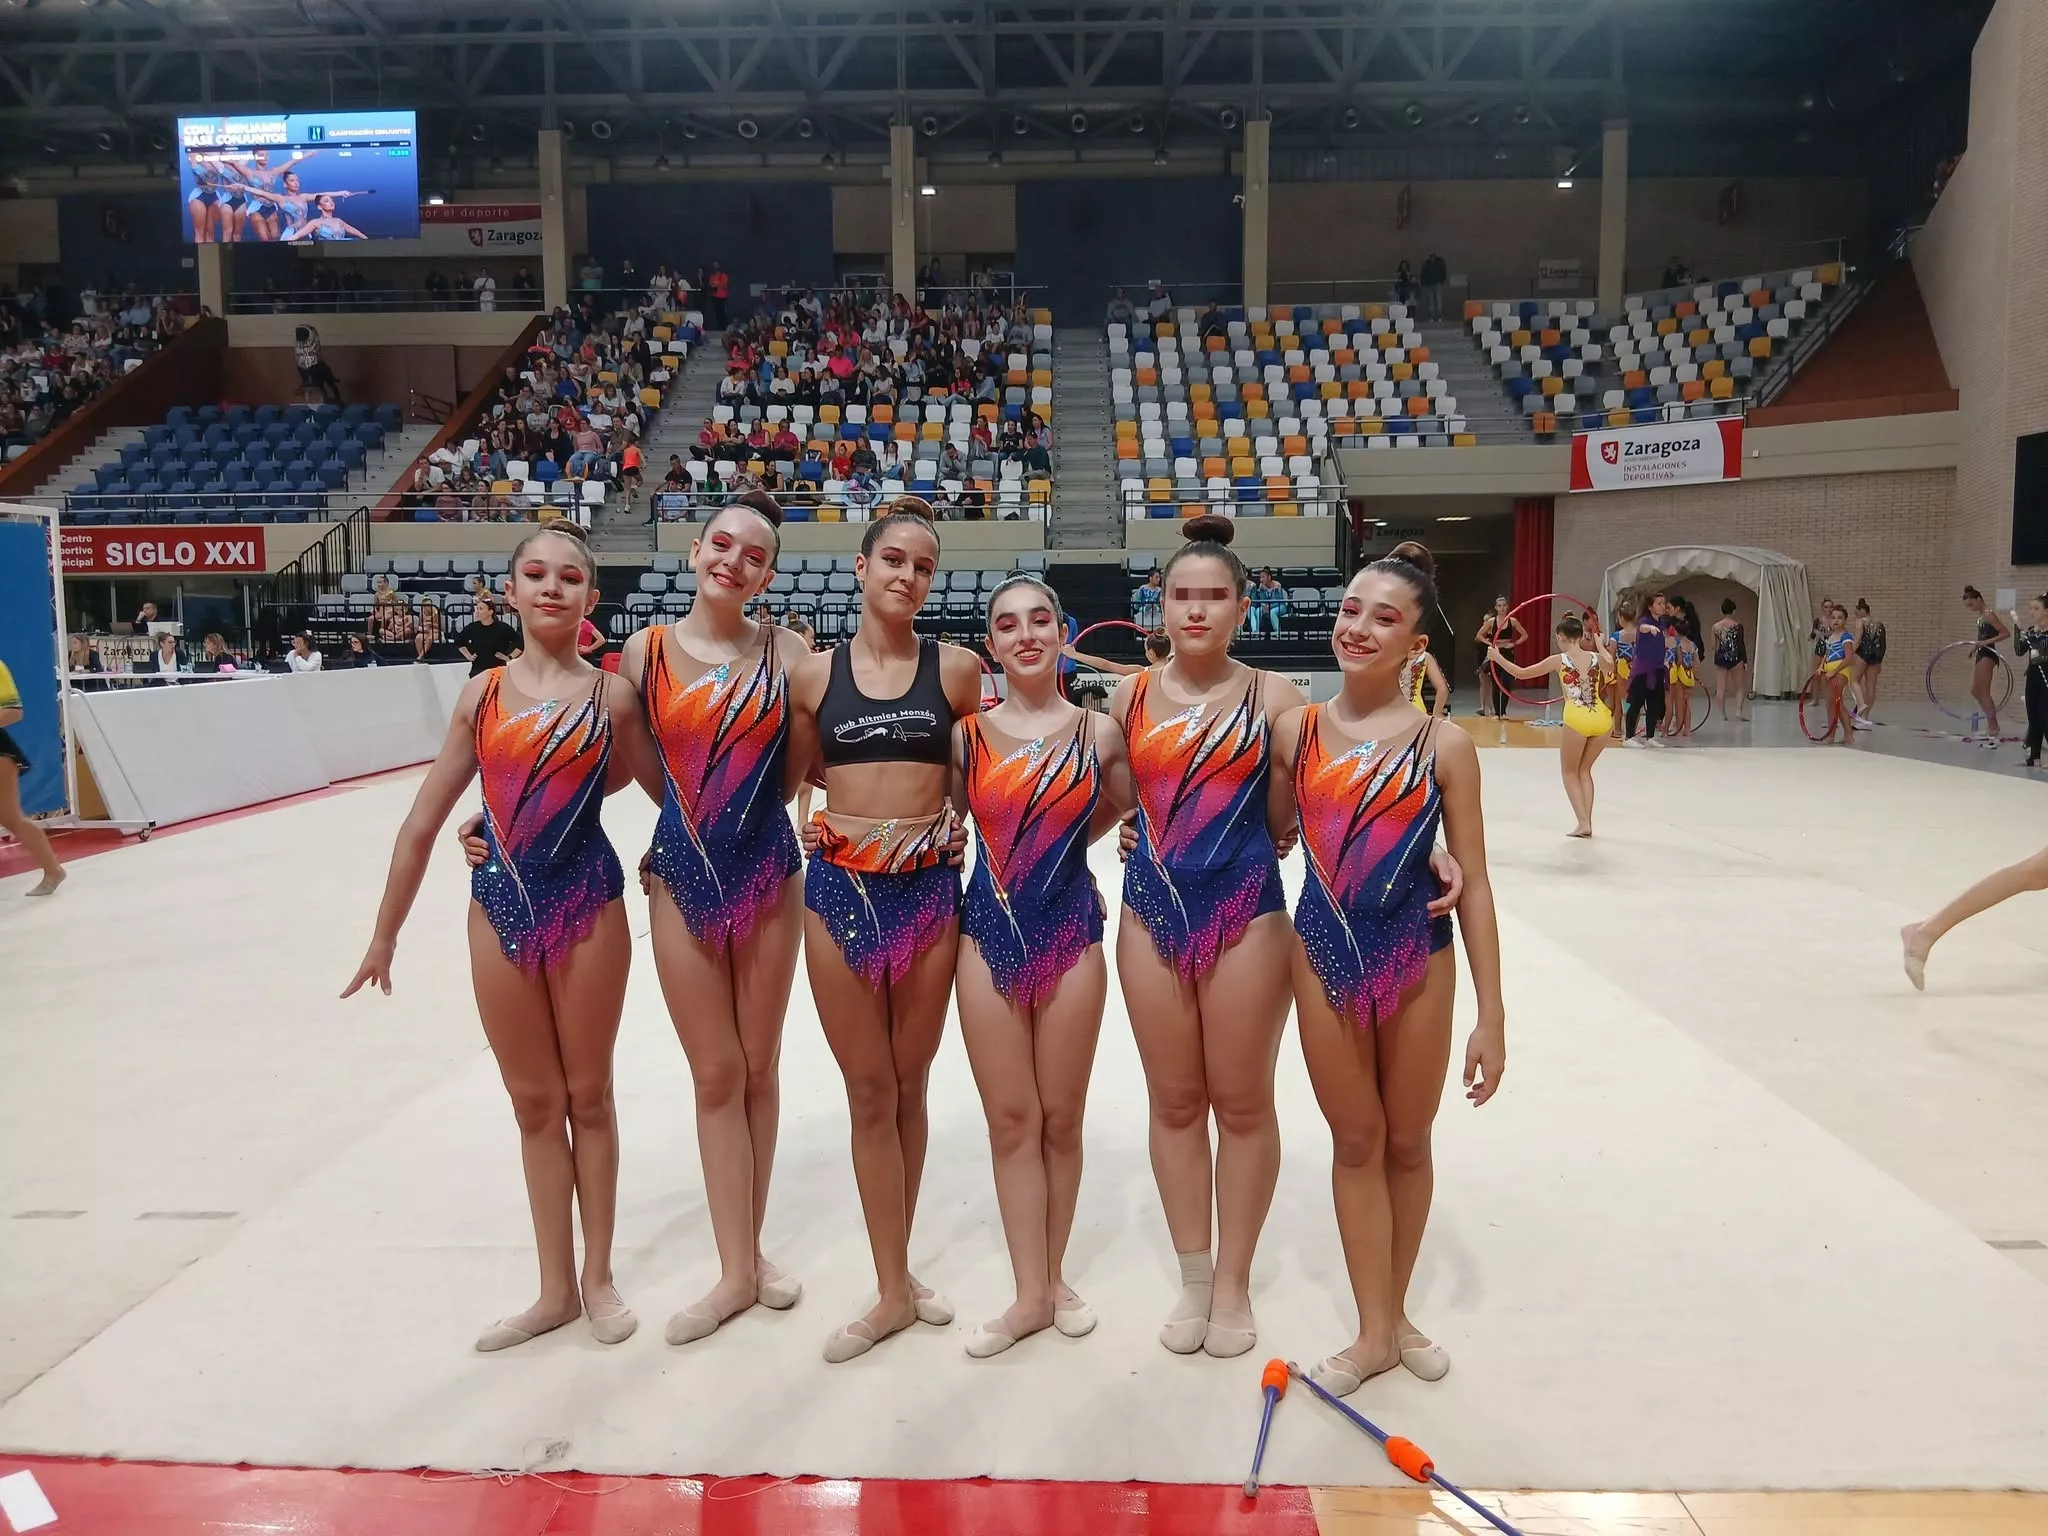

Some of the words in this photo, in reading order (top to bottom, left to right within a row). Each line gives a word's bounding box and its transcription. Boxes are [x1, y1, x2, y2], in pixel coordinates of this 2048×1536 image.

[216, 132, 288, 145] CONJUNTOS
[443, 208, 455, 217] el
[460, 207, 510, 219] deporte
[1624, 438, 1701, 458] Zaragoza
[1623, 461, 1687, 473] INSTALACIONES
[1623, 471, 1675, 482] DEPORTIVAS
[60, 534, 92, 543] Centro
[106, 541, 196, 567] SIGLO
[204, 541, 255, 565] XXI
[47, 557, 94, 568] Mnicipal
[1074, 678, 1121, 688] Zaragoz
[833, 720, 856, 734] Club
[899, 709, 936, 719] Monzón
